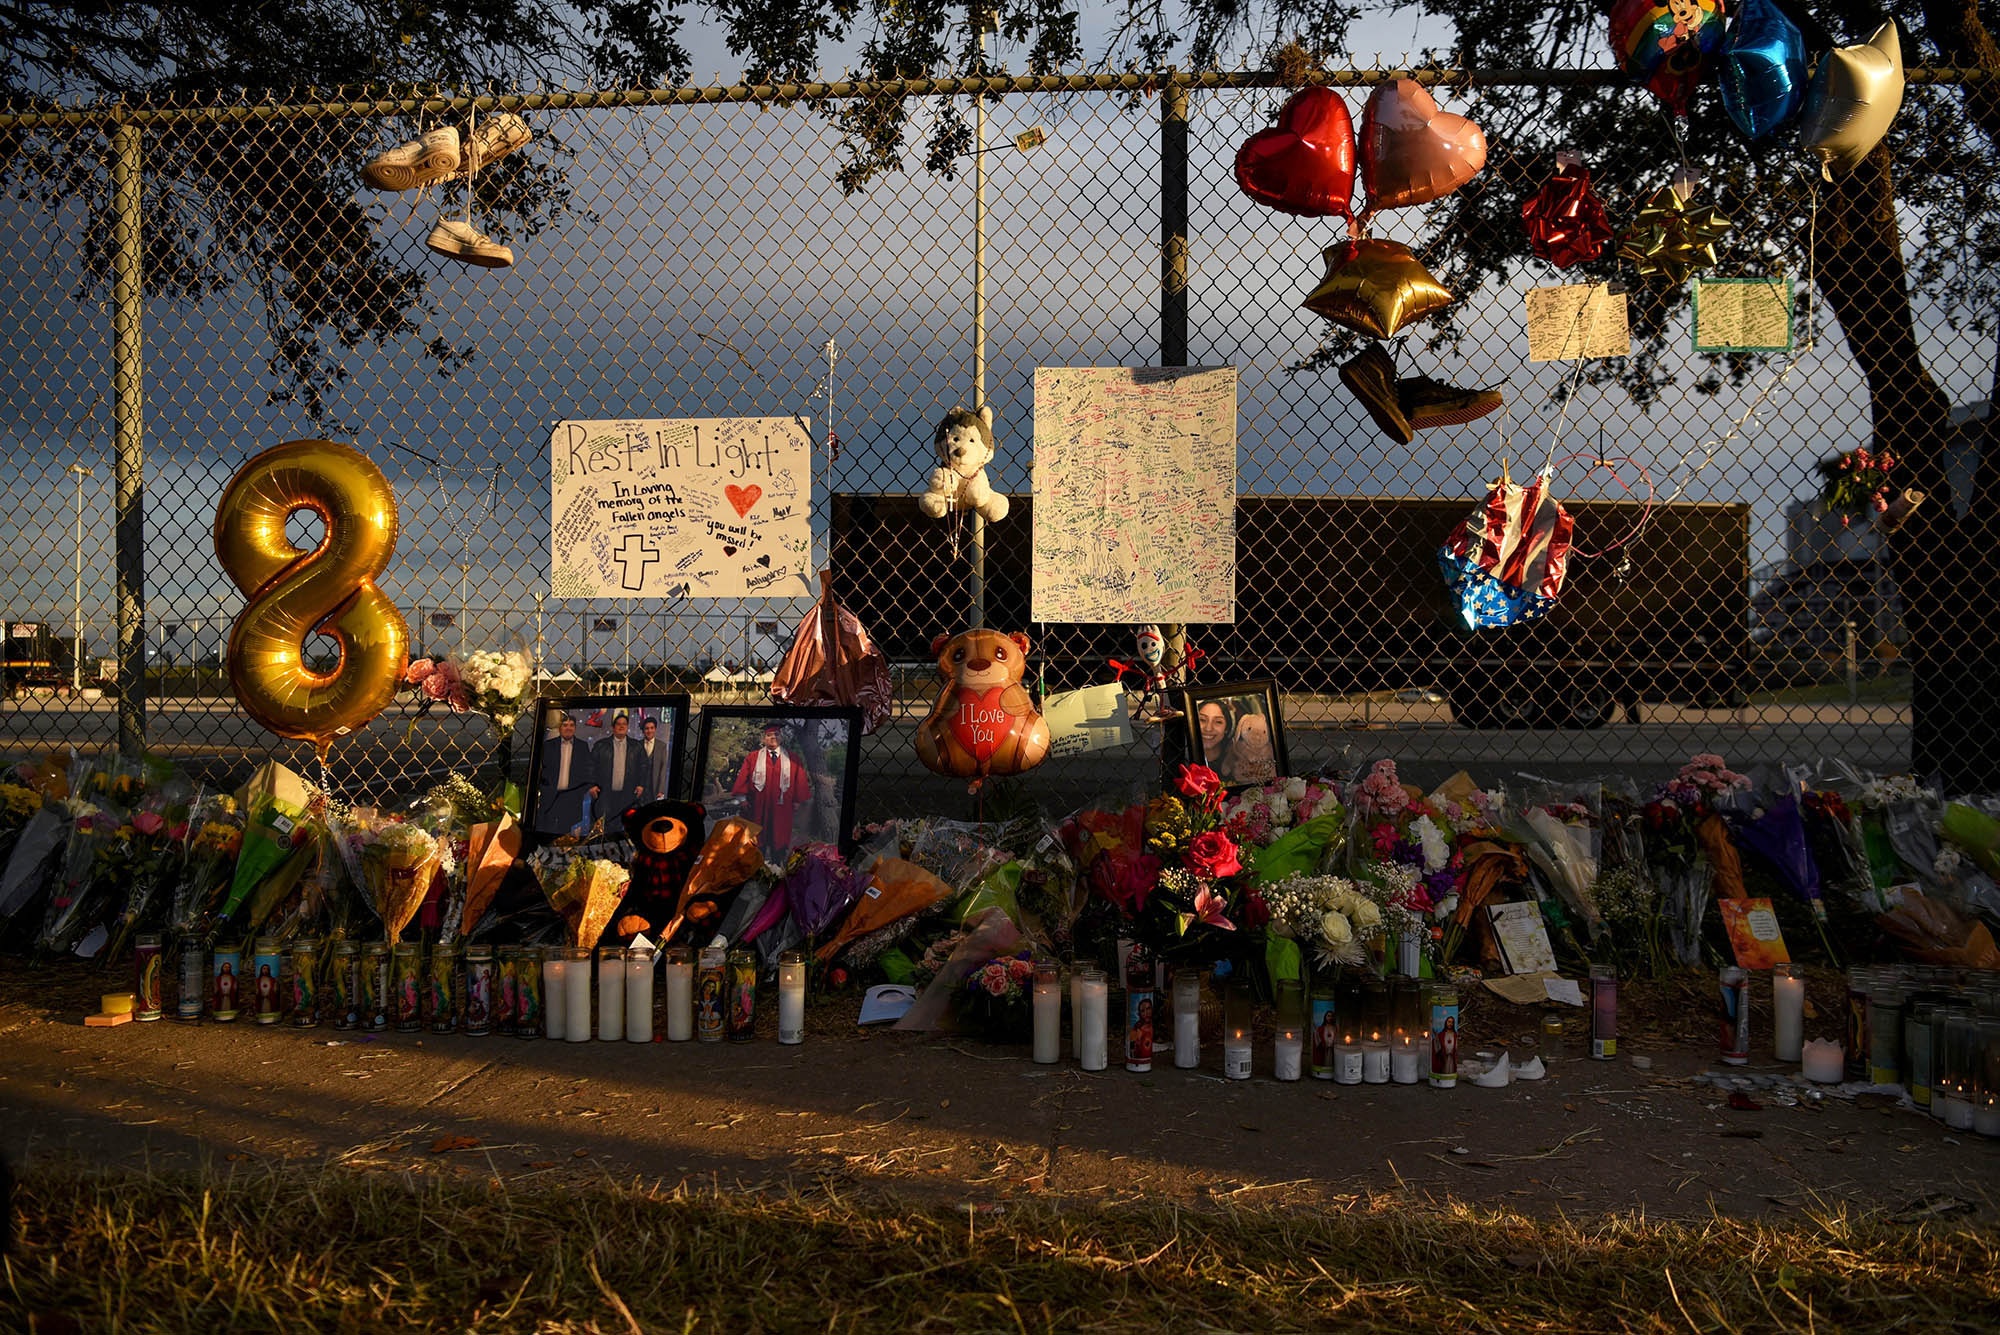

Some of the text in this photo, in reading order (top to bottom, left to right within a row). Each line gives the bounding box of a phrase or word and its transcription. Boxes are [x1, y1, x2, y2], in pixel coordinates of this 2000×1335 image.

[567, 424, 644, 475] Rest
[656, 431, 681, 469] In
[694, 425, 779, 479] Light
[612, 480, 630, 498] In
[634, 482, 676, 501] Loving
[597, 495, 683, 511] memory of the
[611, 510, 645, 523] Fallen
[647, 507, 686, 524] angels
[706, 520, 762, 541] you will be
[960, 703, 1005, 725] I Love
[970, 724, 994, 745] You
